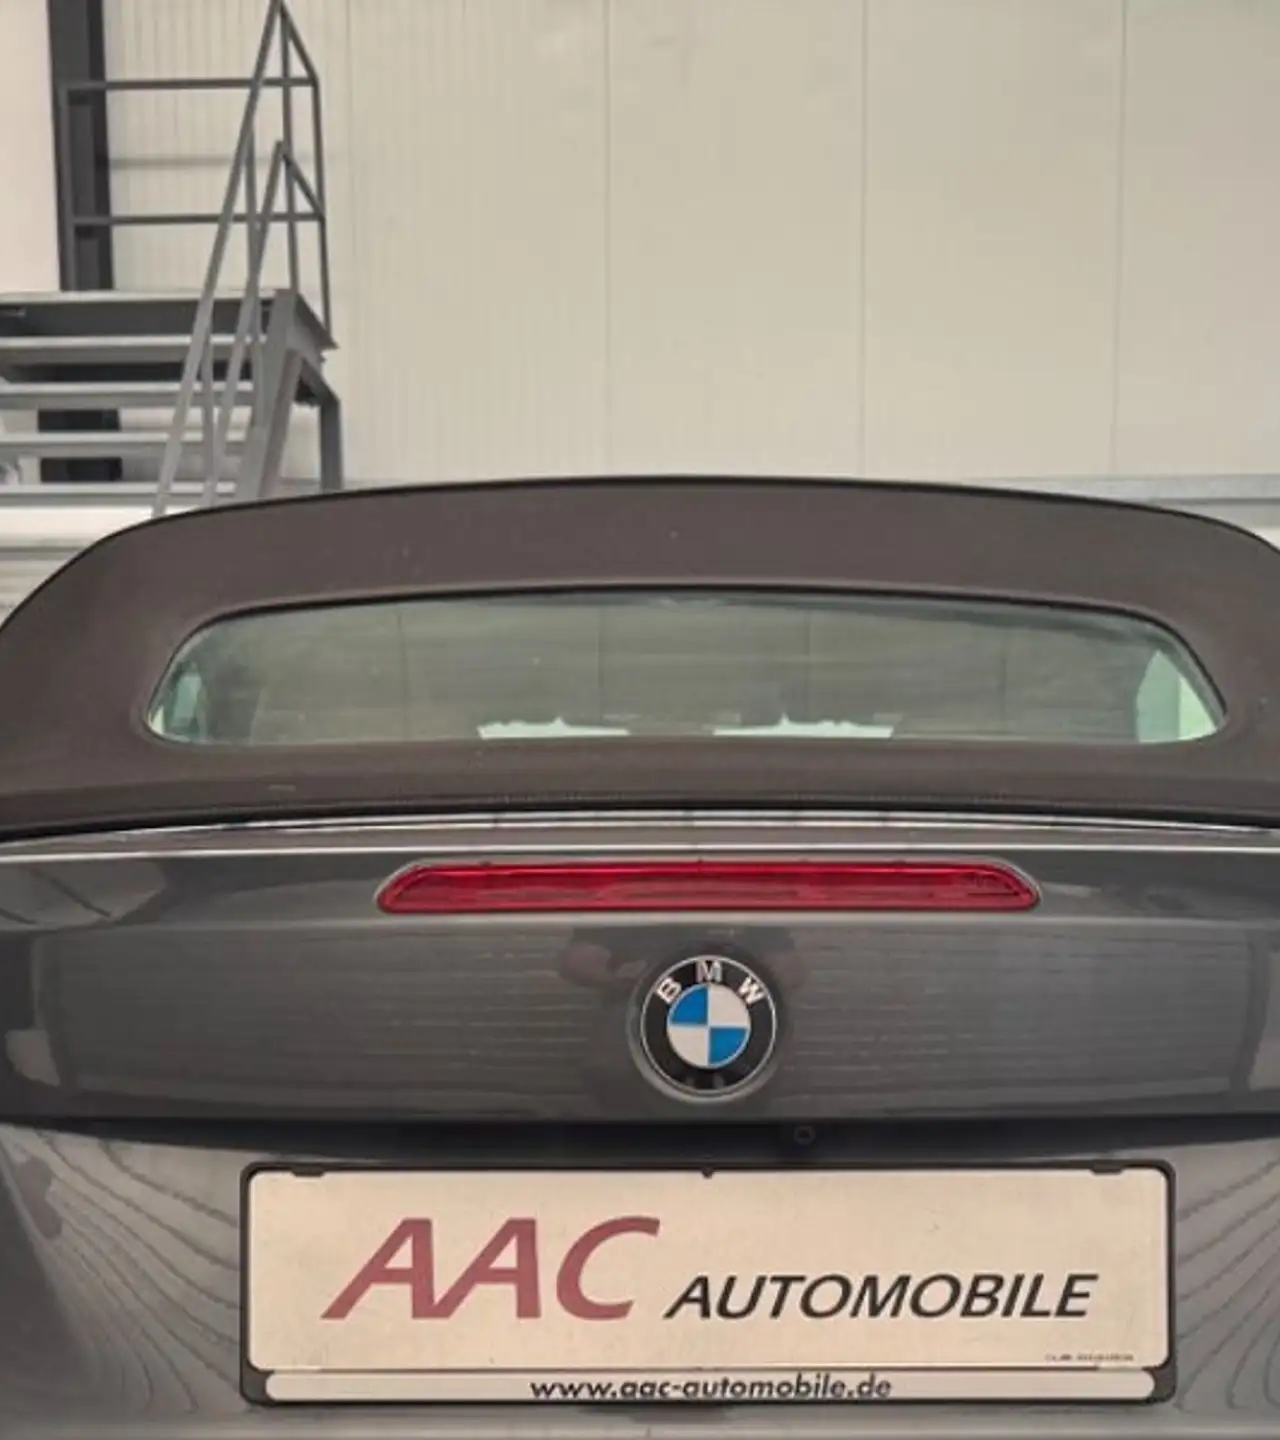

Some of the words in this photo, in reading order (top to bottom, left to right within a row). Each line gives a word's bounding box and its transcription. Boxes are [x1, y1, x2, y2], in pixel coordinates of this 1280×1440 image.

[656, 960, 766, 1004] BMW
[321, 1216, 661, 1321] AAC
[663, 1273, 1099, 1320] AUTOMOBILE
[530, 1373, 892, 1400] www.aac-automobile.de
